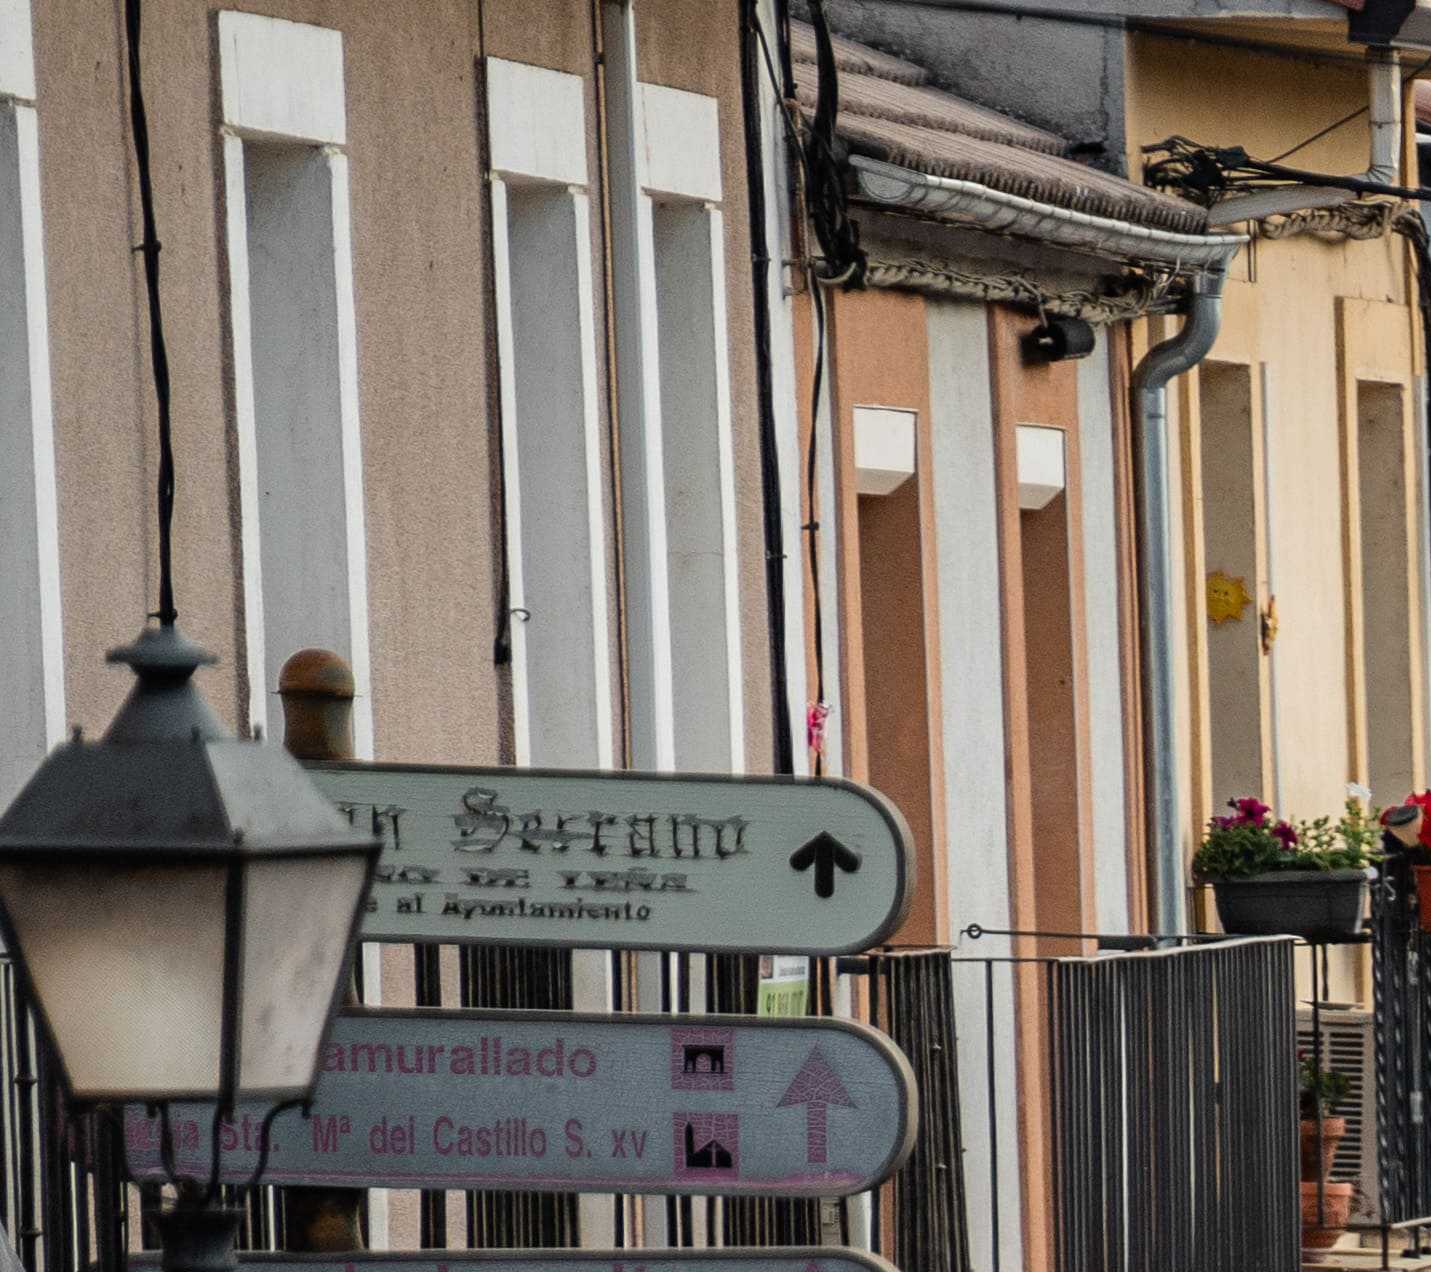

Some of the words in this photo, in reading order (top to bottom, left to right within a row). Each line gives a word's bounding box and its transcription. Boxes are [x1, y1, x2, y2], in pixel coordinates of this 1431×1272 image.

[323, 1036, 598, 1078] amurallado
[368, 1115, 416, 1155] del
[432, 1115, 548, 1158] Castillo
[563, 1118, 593, 1159] S.
